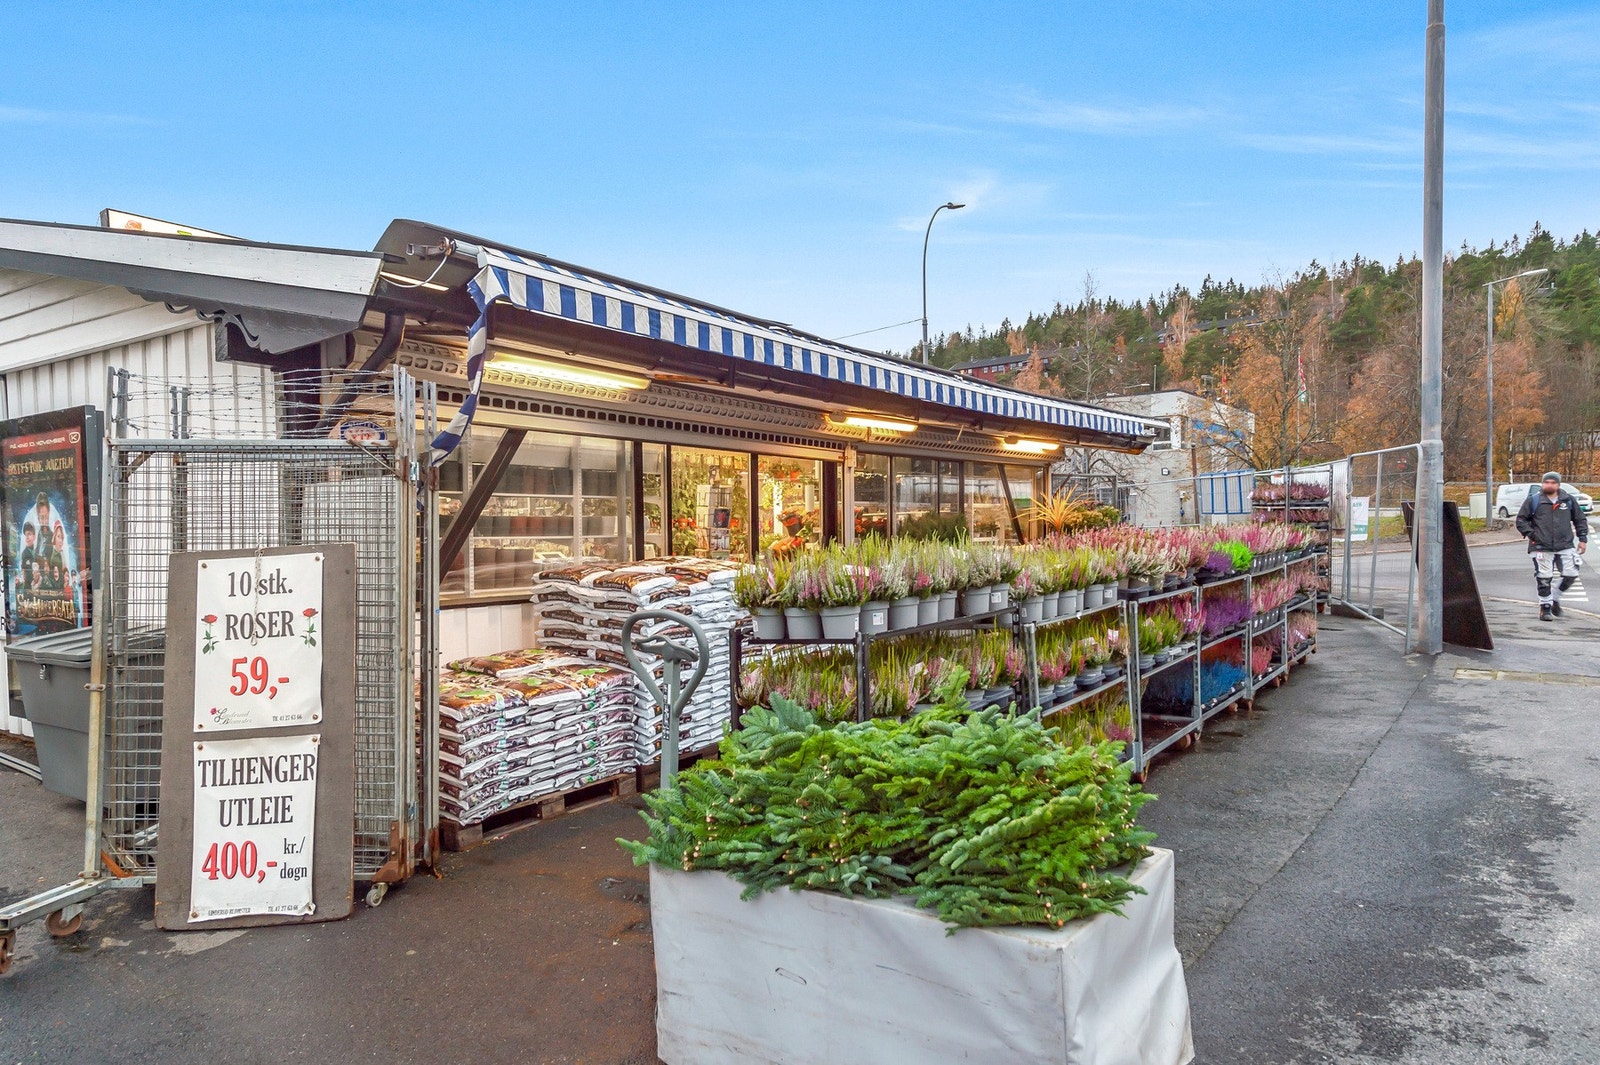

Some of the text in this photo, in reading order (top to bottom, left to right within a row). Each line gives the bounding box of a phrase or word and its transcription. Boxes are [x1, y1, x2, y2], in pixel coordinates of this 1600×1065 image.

[36, 437, 65, 446] NOVEMBER
[228, 568, 293, 598] 10 stk.
[225, 610, 295, 641] ROSER
[230, 656, 290, 700] 59,-
[198, 753, 316, 788] TILHENGER
[219, 795, 293, 827] UTLEIE
[283, 836, 306, 855] kr./
[201, 840, 277, 883] 400,-
[280, 862, 307, 881] døgn
